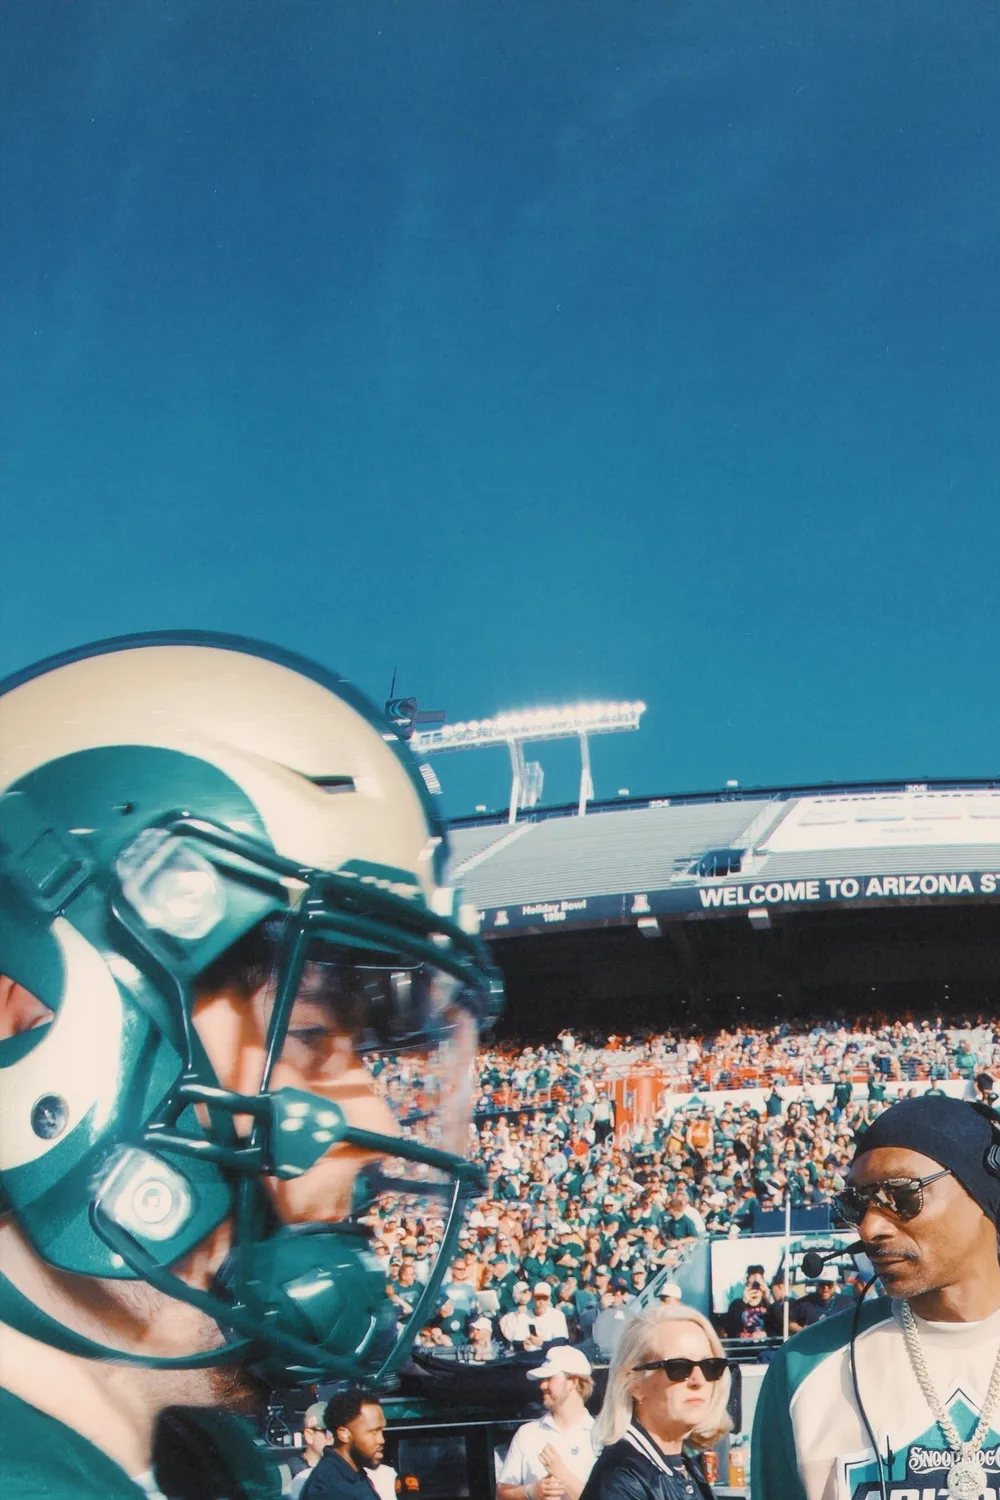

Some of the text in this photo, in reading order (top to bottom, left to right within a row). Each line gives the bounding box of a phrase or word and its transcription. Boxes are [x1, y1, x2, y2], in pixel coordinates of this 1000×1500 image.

[699, 881, 820, 908] WELCOME
[826, 879, 859, 898] TO
[866, 874, 975, 897] ARIZONA
[522, 899, 587, 916] Holiday Bowl
